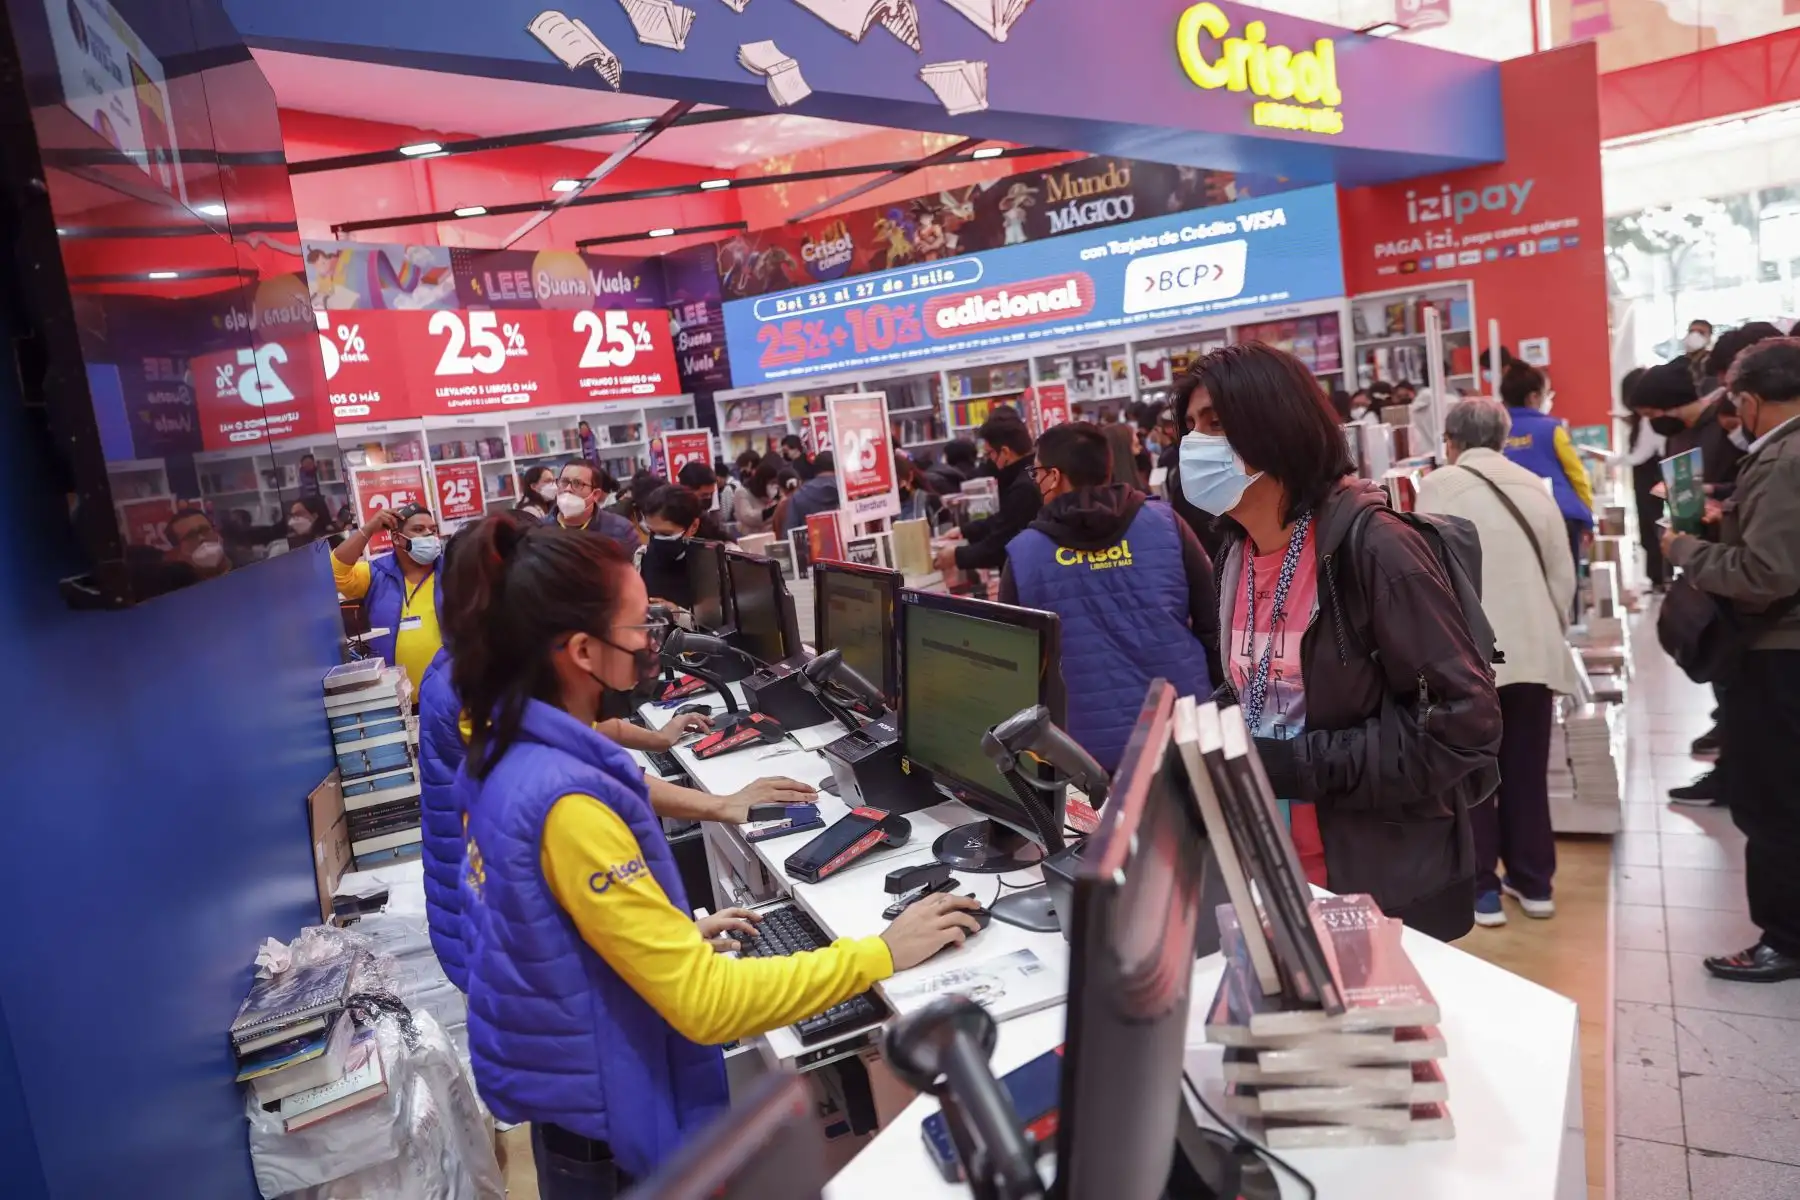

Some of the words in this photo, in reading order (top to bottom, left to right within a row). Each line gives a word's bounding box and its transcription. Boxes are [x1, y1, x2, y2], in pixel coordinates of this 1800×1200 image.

[1177, 2, 1342, 106] Crisol
[1046, 162, 1131, 202] Mundo
[1406, 178, 1534, 225] izipay
[1046, 194, 1134, 234] MÁGICO
[801, 232, 853, 262] Crisol
[1080, 245, 1108, 261] con
[1107, 236, 1159, 255] Tarjeta
[1159, 230, 1180, 246] de
[1236, 208, 1287, 233] VISA
[1374, 237, 1423, 258] PAGA
[588, 268, 632, 297] Vuela
[775, 296, 803, 313] Del
[808, 291, 827, 307] 22
[833, 287, 850, 302] al
[856, 282, 875, 297] 27
[882, 278, 904, 293] de
[911, 268, 955, 288] Julio
[1158, 263, 1210, 292] BCP
[935, 279, 1083, 330] adicional
[428, 310, 525, 376] 25%
[573, 310, 651, 368] 25%
[359, 390, 380, 402] MÁS
[435, 386, 478, 398] LLEVANDO
[1055, 539, 1132, 566] Crisol
[589, 852, 645, 894] Crisol
